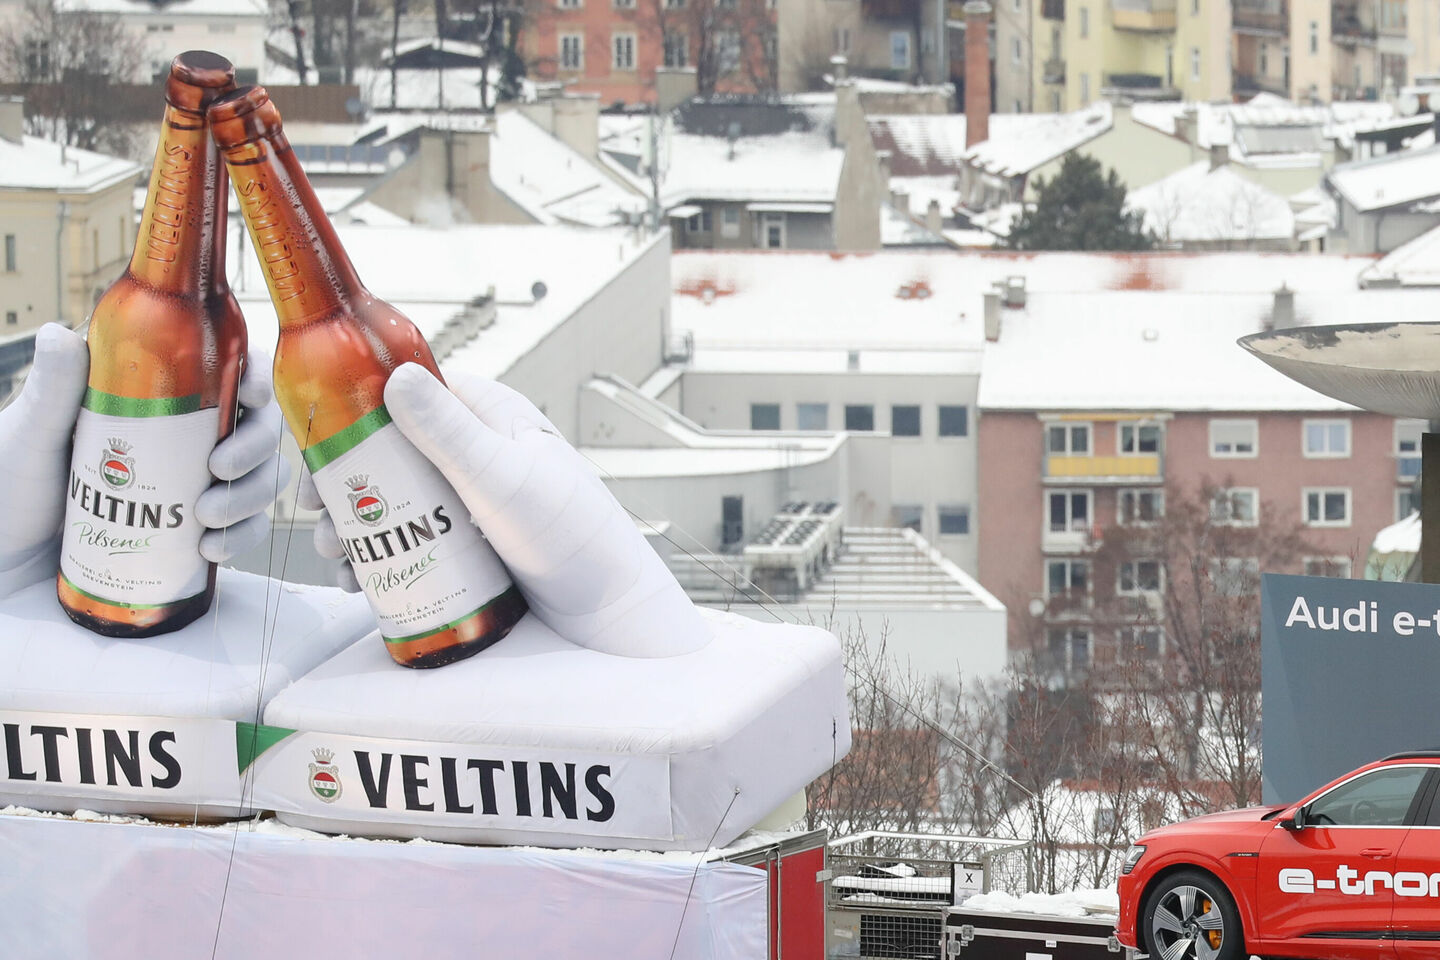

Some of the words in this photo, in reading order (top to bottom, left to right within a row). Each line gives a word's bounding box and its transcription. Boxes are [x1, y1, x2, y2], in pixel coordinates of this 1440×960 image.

[70, 469, 183, 529] VELTINS
[340, 504, 452, 563] VELTINS
[1285, 596, 1378, 633] Audi
[353, 750, 616, 822] VELTINS
